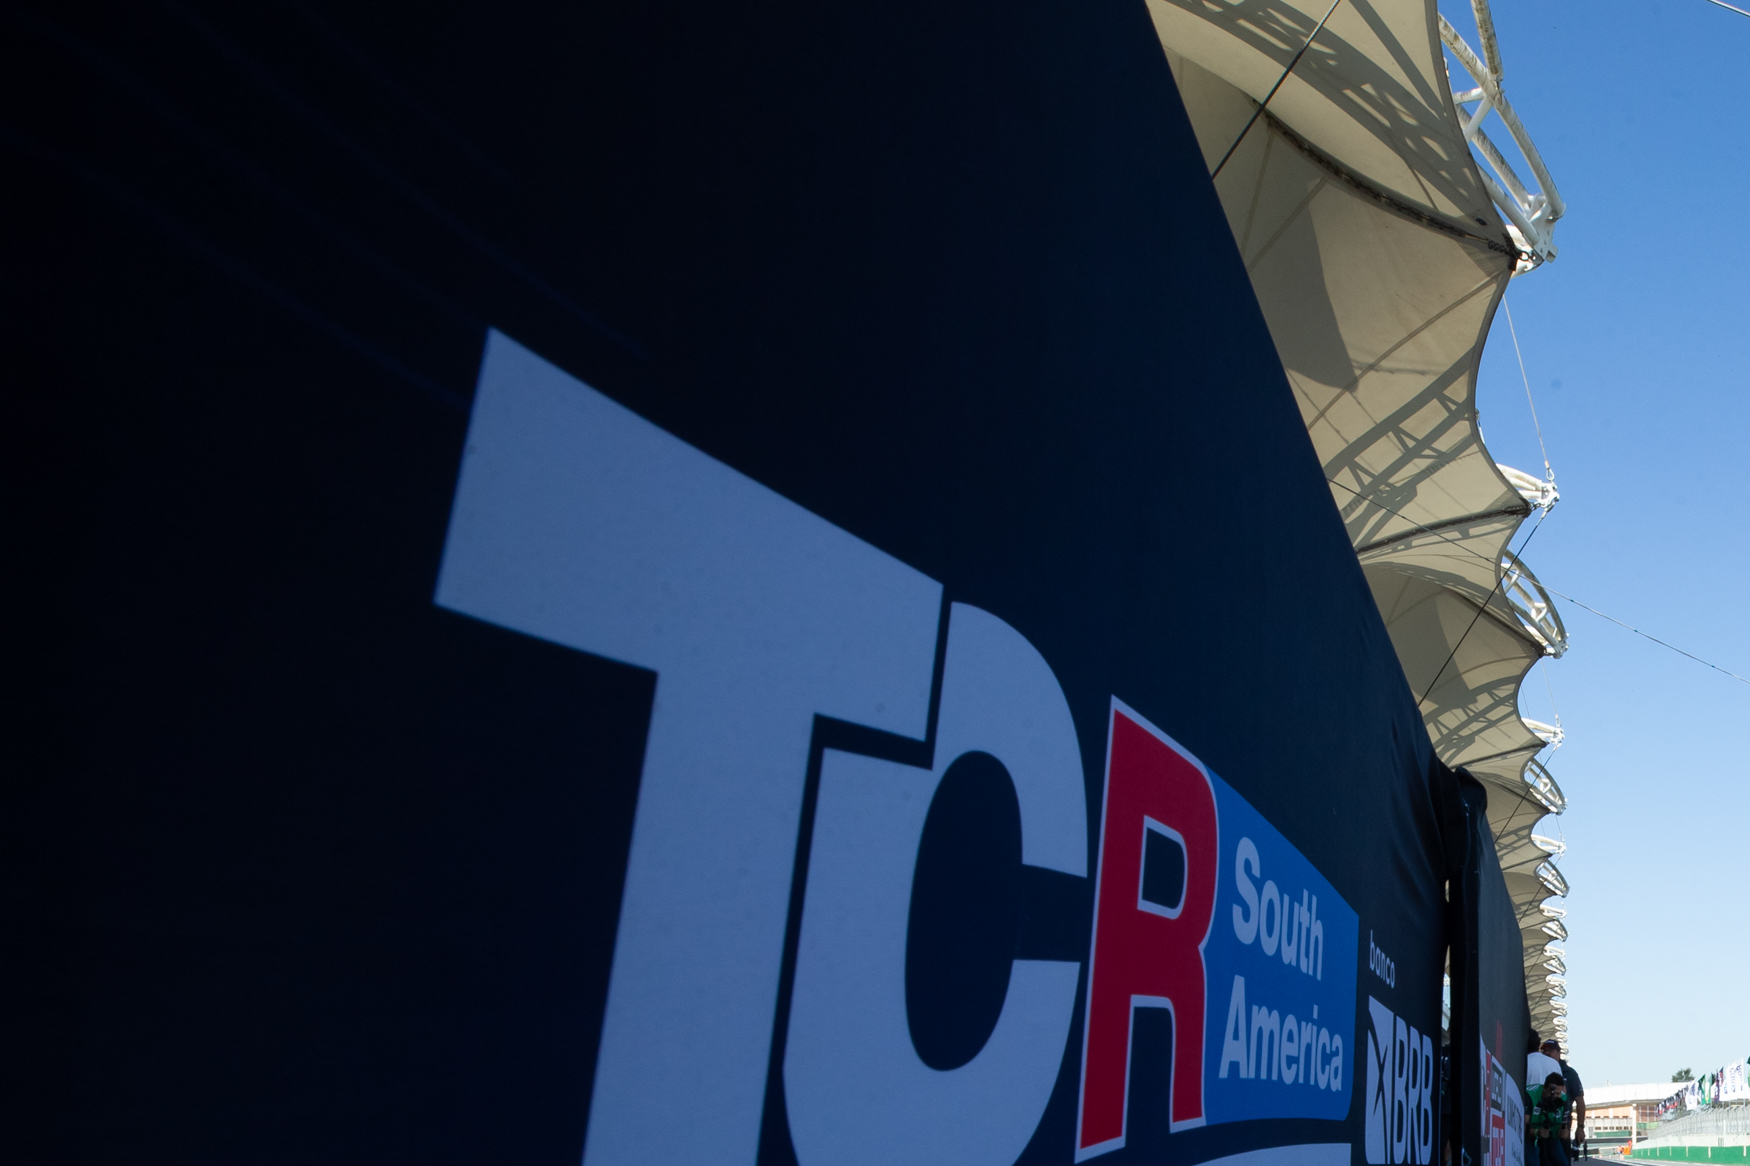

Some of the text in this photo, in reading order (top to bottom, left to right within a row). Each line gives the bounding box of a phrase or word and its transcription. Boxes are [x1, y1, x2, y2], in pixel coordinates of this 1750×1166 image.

[1232, 837, 1324, 981] South
[1369, 930, 1395, 988] banco
[1219, 974, 1343, 1091] America
[1393, 1016, 1432, 1166] BRB
